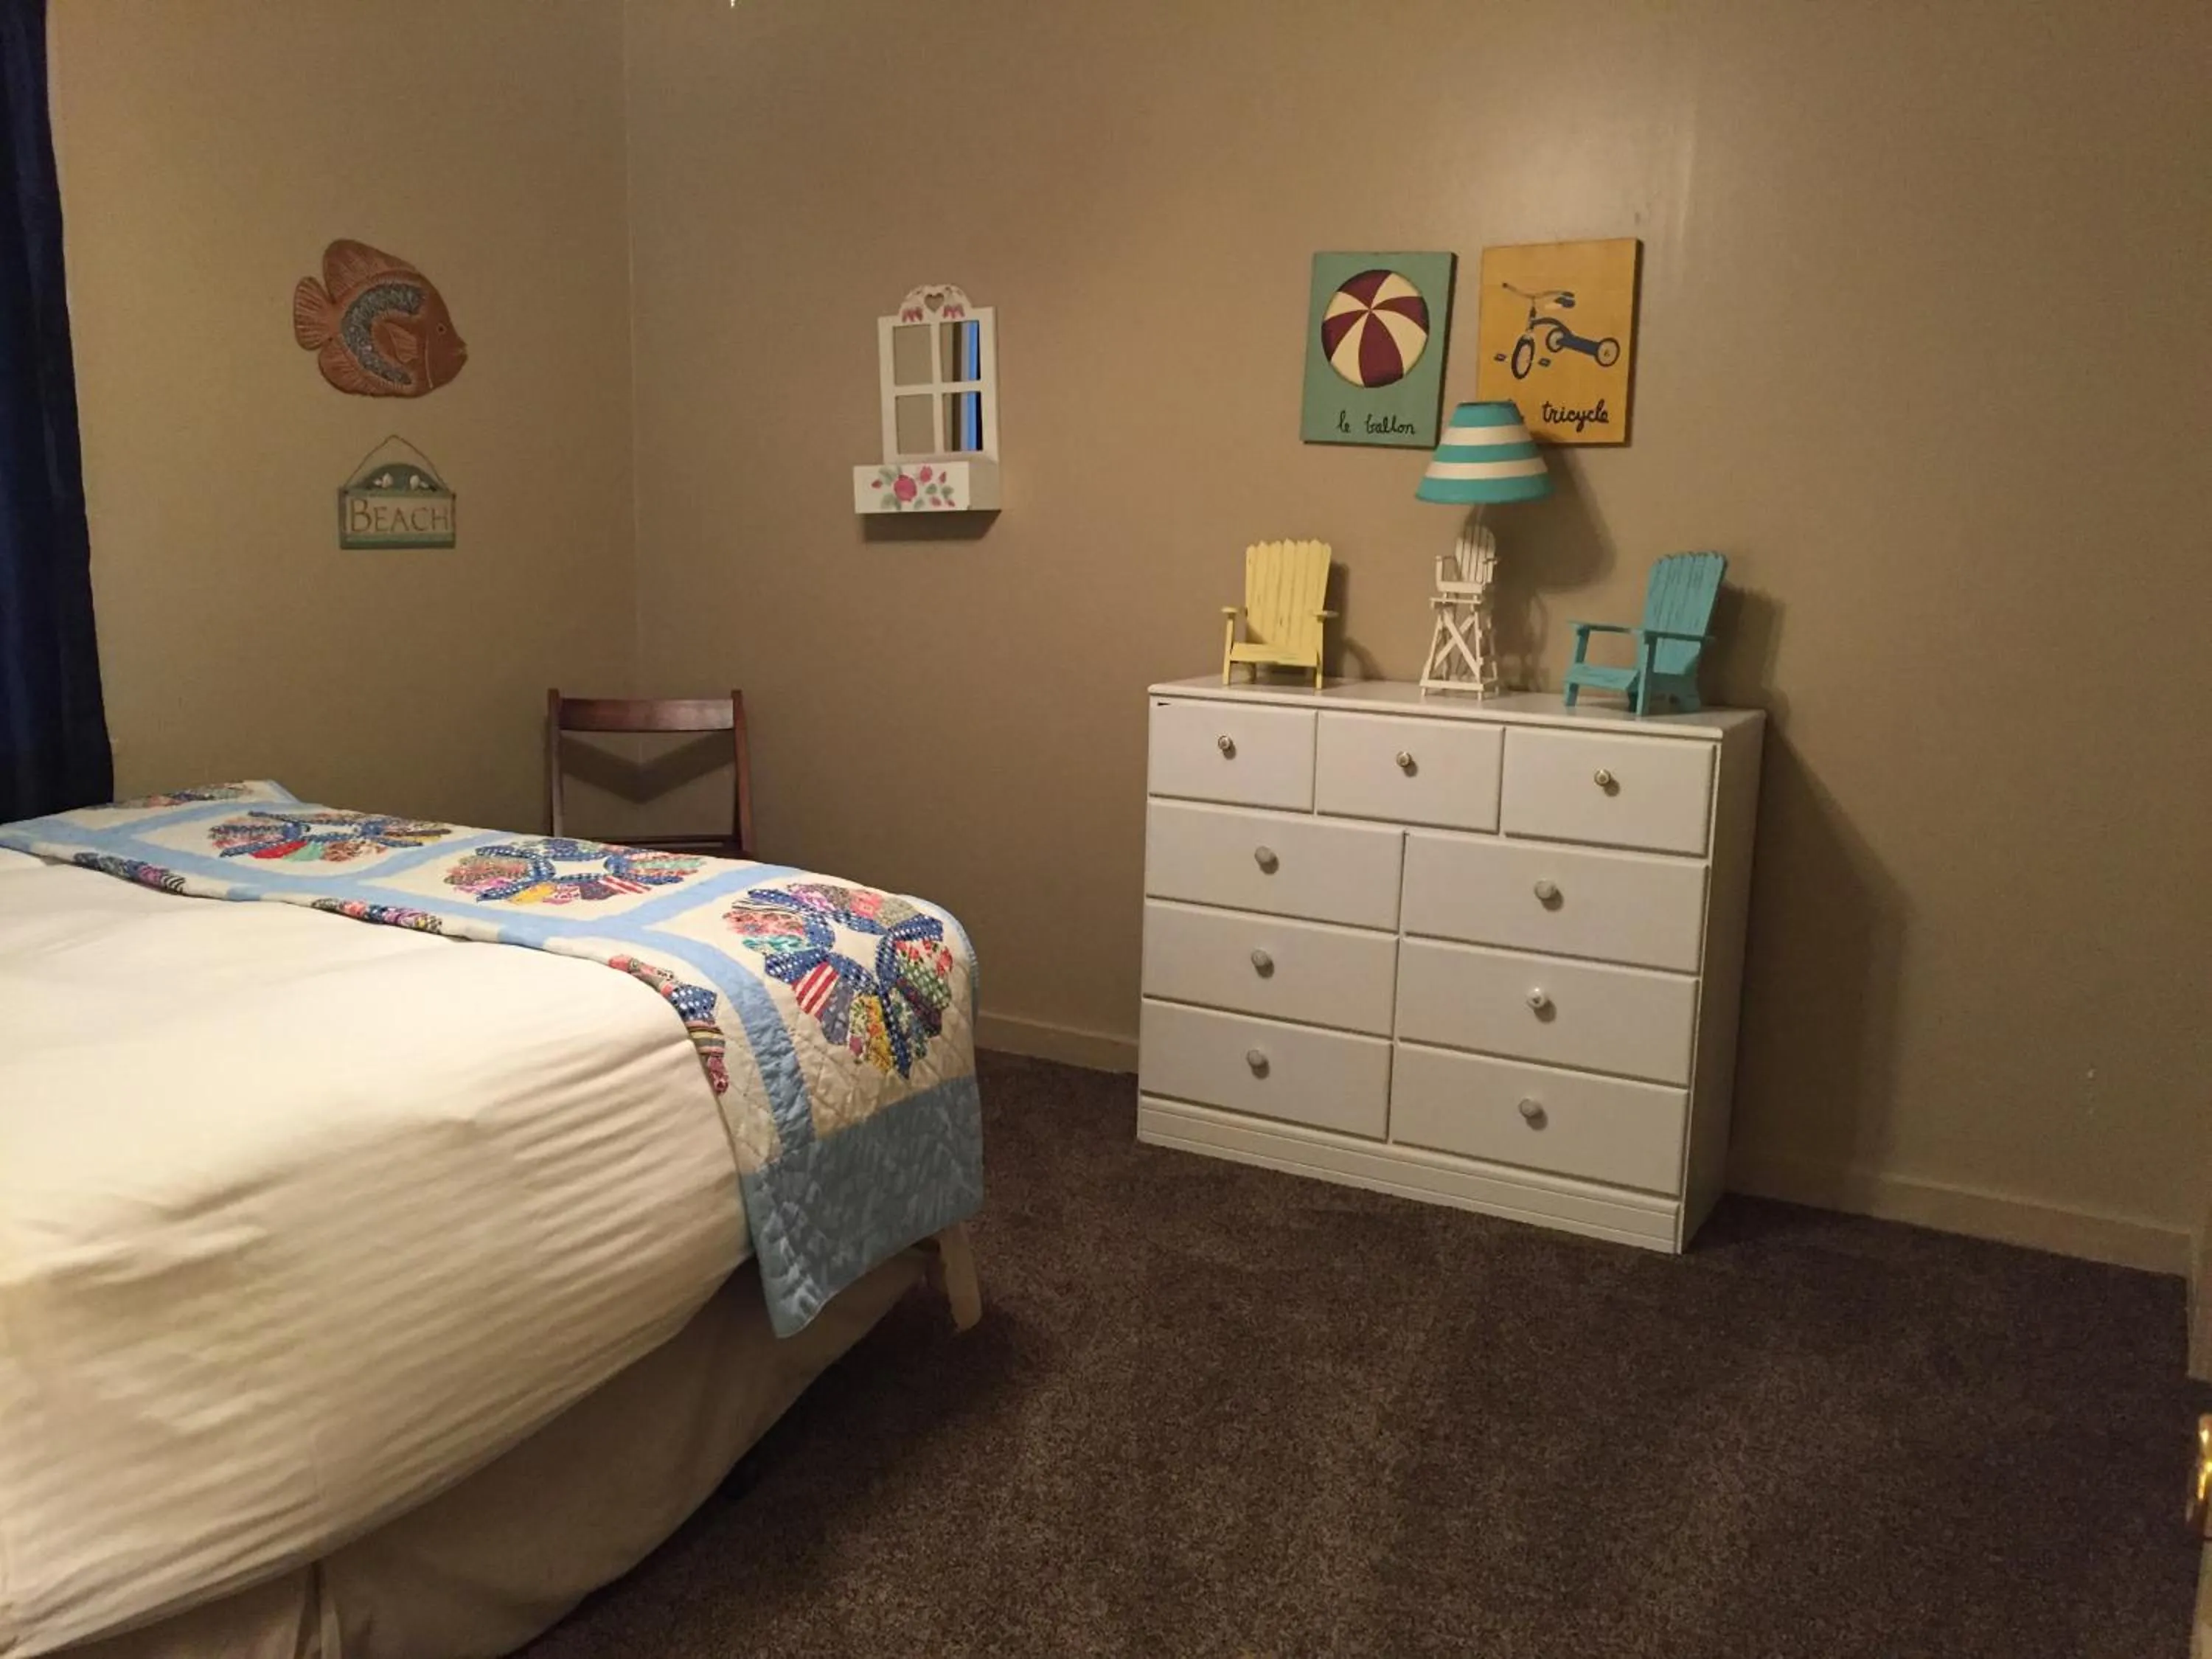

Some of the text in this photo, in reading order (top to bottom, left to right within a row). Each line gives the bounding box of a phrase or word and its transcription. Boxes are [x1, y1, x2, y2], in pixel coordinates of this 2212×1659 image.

[1336, 409, 1351, 433] le
[1542, 398, 1609, 432] tricycle
[350, 498, 448, 532] BEACH
